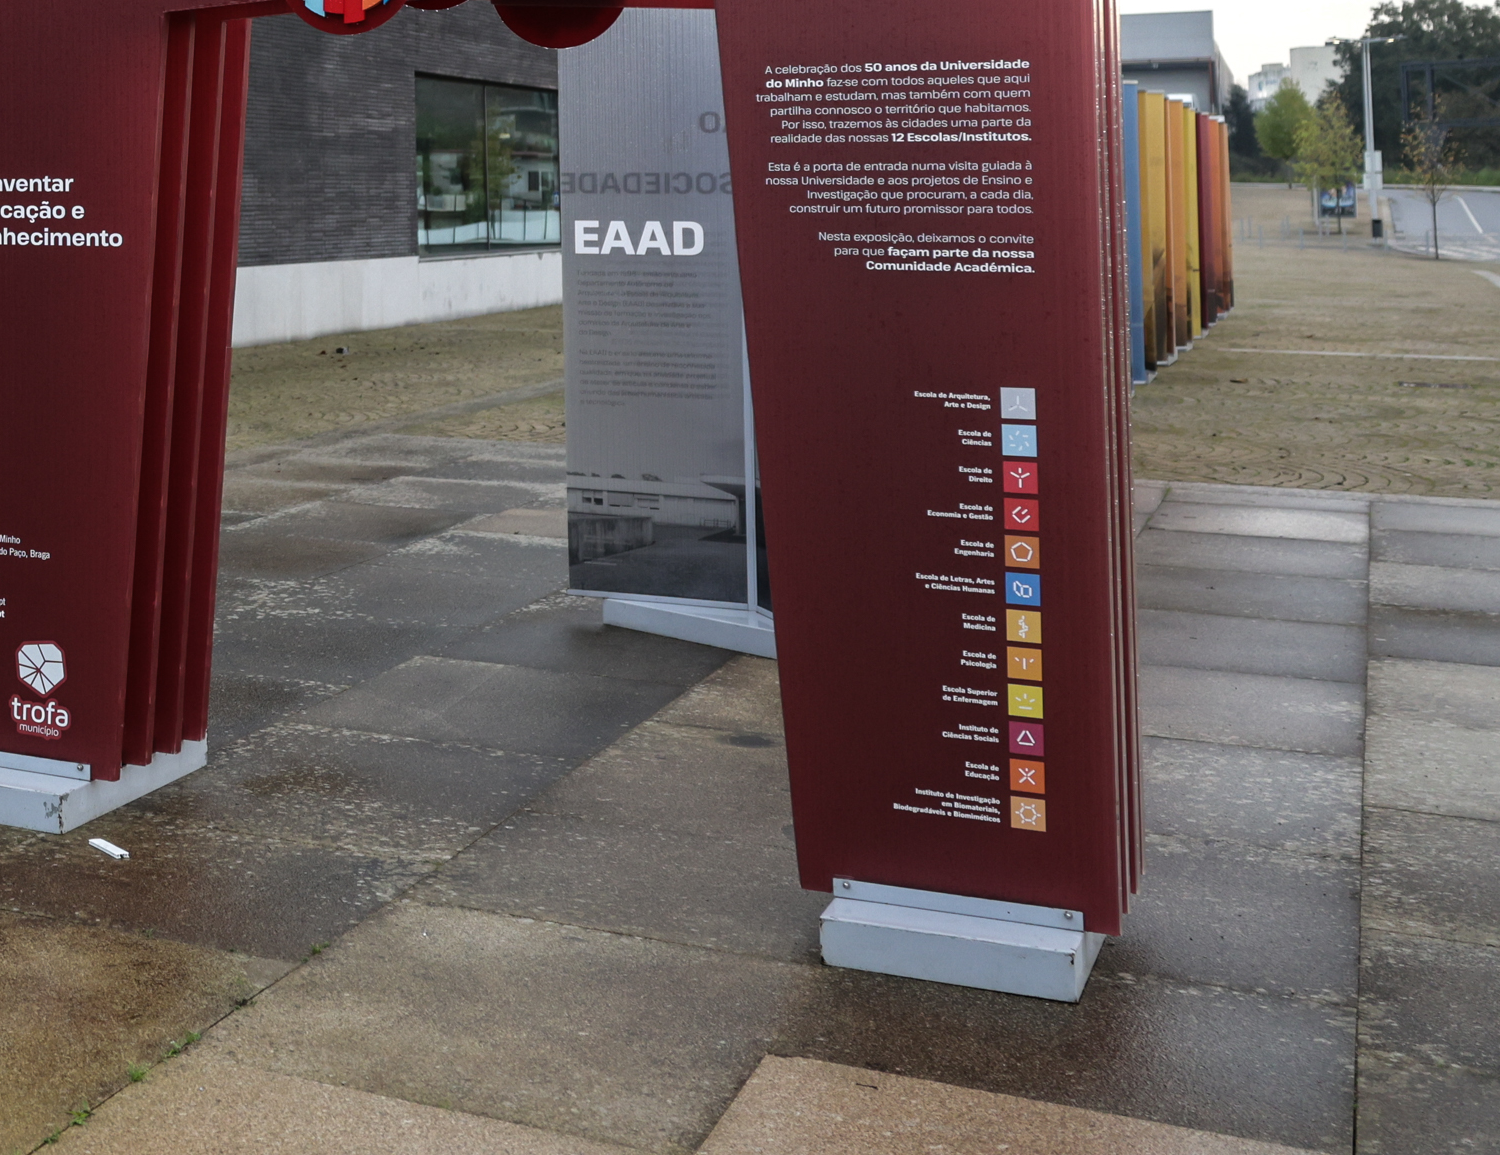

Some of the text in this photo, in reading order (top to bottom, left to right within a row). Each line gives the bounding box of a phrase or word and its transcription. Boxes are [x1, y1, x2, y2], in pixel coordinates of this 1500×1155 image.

[765, 59, 1030, 75] A celebração dos 50 anos da Universidade
[766, 73, 1030, 88] do Minho faz-se com todos aqueles que aqui
[756, 89, 1031, 102] trabalham e estudam, mas também com quem
[770, 103, 1031, 117] partilha connosco o território que habitamos.
[781, 117, 1031, 129] Por isso, trazemos às cidades uma parte da
[770, 134, 822, 143] realidade
[825, 133, 846, 143] das
[891, 133, 905, 142] 12
[907, 131, 1032, 142] Escolas/Institutos.
[768, 162, 791, 172] Esta
[793, 161, 801, 172] é
[813, 163, 843, 173] porta
[846, 162, 861, 171] de
[864, 161, 908, 171] entrada
[911, 163, 946, 171] numa
[948, 161, 979, 171] visita
[981, 160, 1022, 172] guiada
[1025, 160, 1032, 170] à
[765, 175, 1033, 187] nossa Universidade e aos projetos de Ensino e
[807, 189, 1034, 201] Investigação que procuram, a cada dia,
[71, 205, 85, 219] e
[789, 203, 1034, 215] construir um futuro promissor para todos.
[574, 219, 705, 256] EAAD
[818, 231, 1034, 244] Nesta exposição, deixamos o convite
[834, 246, 1034, 259] para que façam parte da nossa
[866, 260, 1035, 273] Comunidade Académica.
[914, 390, 937, 398] Escola
[948, 392, 991, 401] Arquitetura,
[966, 402, 991, 410] Design
[961, 438, 992, 446] Ciências
[968, 475, 993, 483] Direito
[927, 509, 961, 518] Economia
[968, 512, 994, 520] Gestão
[0, 534, 21, 544] Minho
[9, 547, 28, 558] Paço,
[30, 549, 50, 560] Braga
[954, 548, 995, 557] Engenharia
[915, 572, 939, 581] Escola
[950, 575, 975, 584] Letras,
[976, 577, 995, 585] Artes
[931, 583, 961, 591] Ciências
[962, 585, 995, 594] Humanas
[963, 622, 996, 631] Medicina
[960, 659, 997, 669] Psicologia
[942, 685, 998, 697] Escola Superior
[953, 695, 998, 706] Enfermagem
[11, 697, 69, 727] trofa
[19, 723, 59, 737] município
[958, 724, 989, 733] Instituto
[942, 731, 999, 743] Ciências Sociais
[965, 770, 1000, 781] Educação
